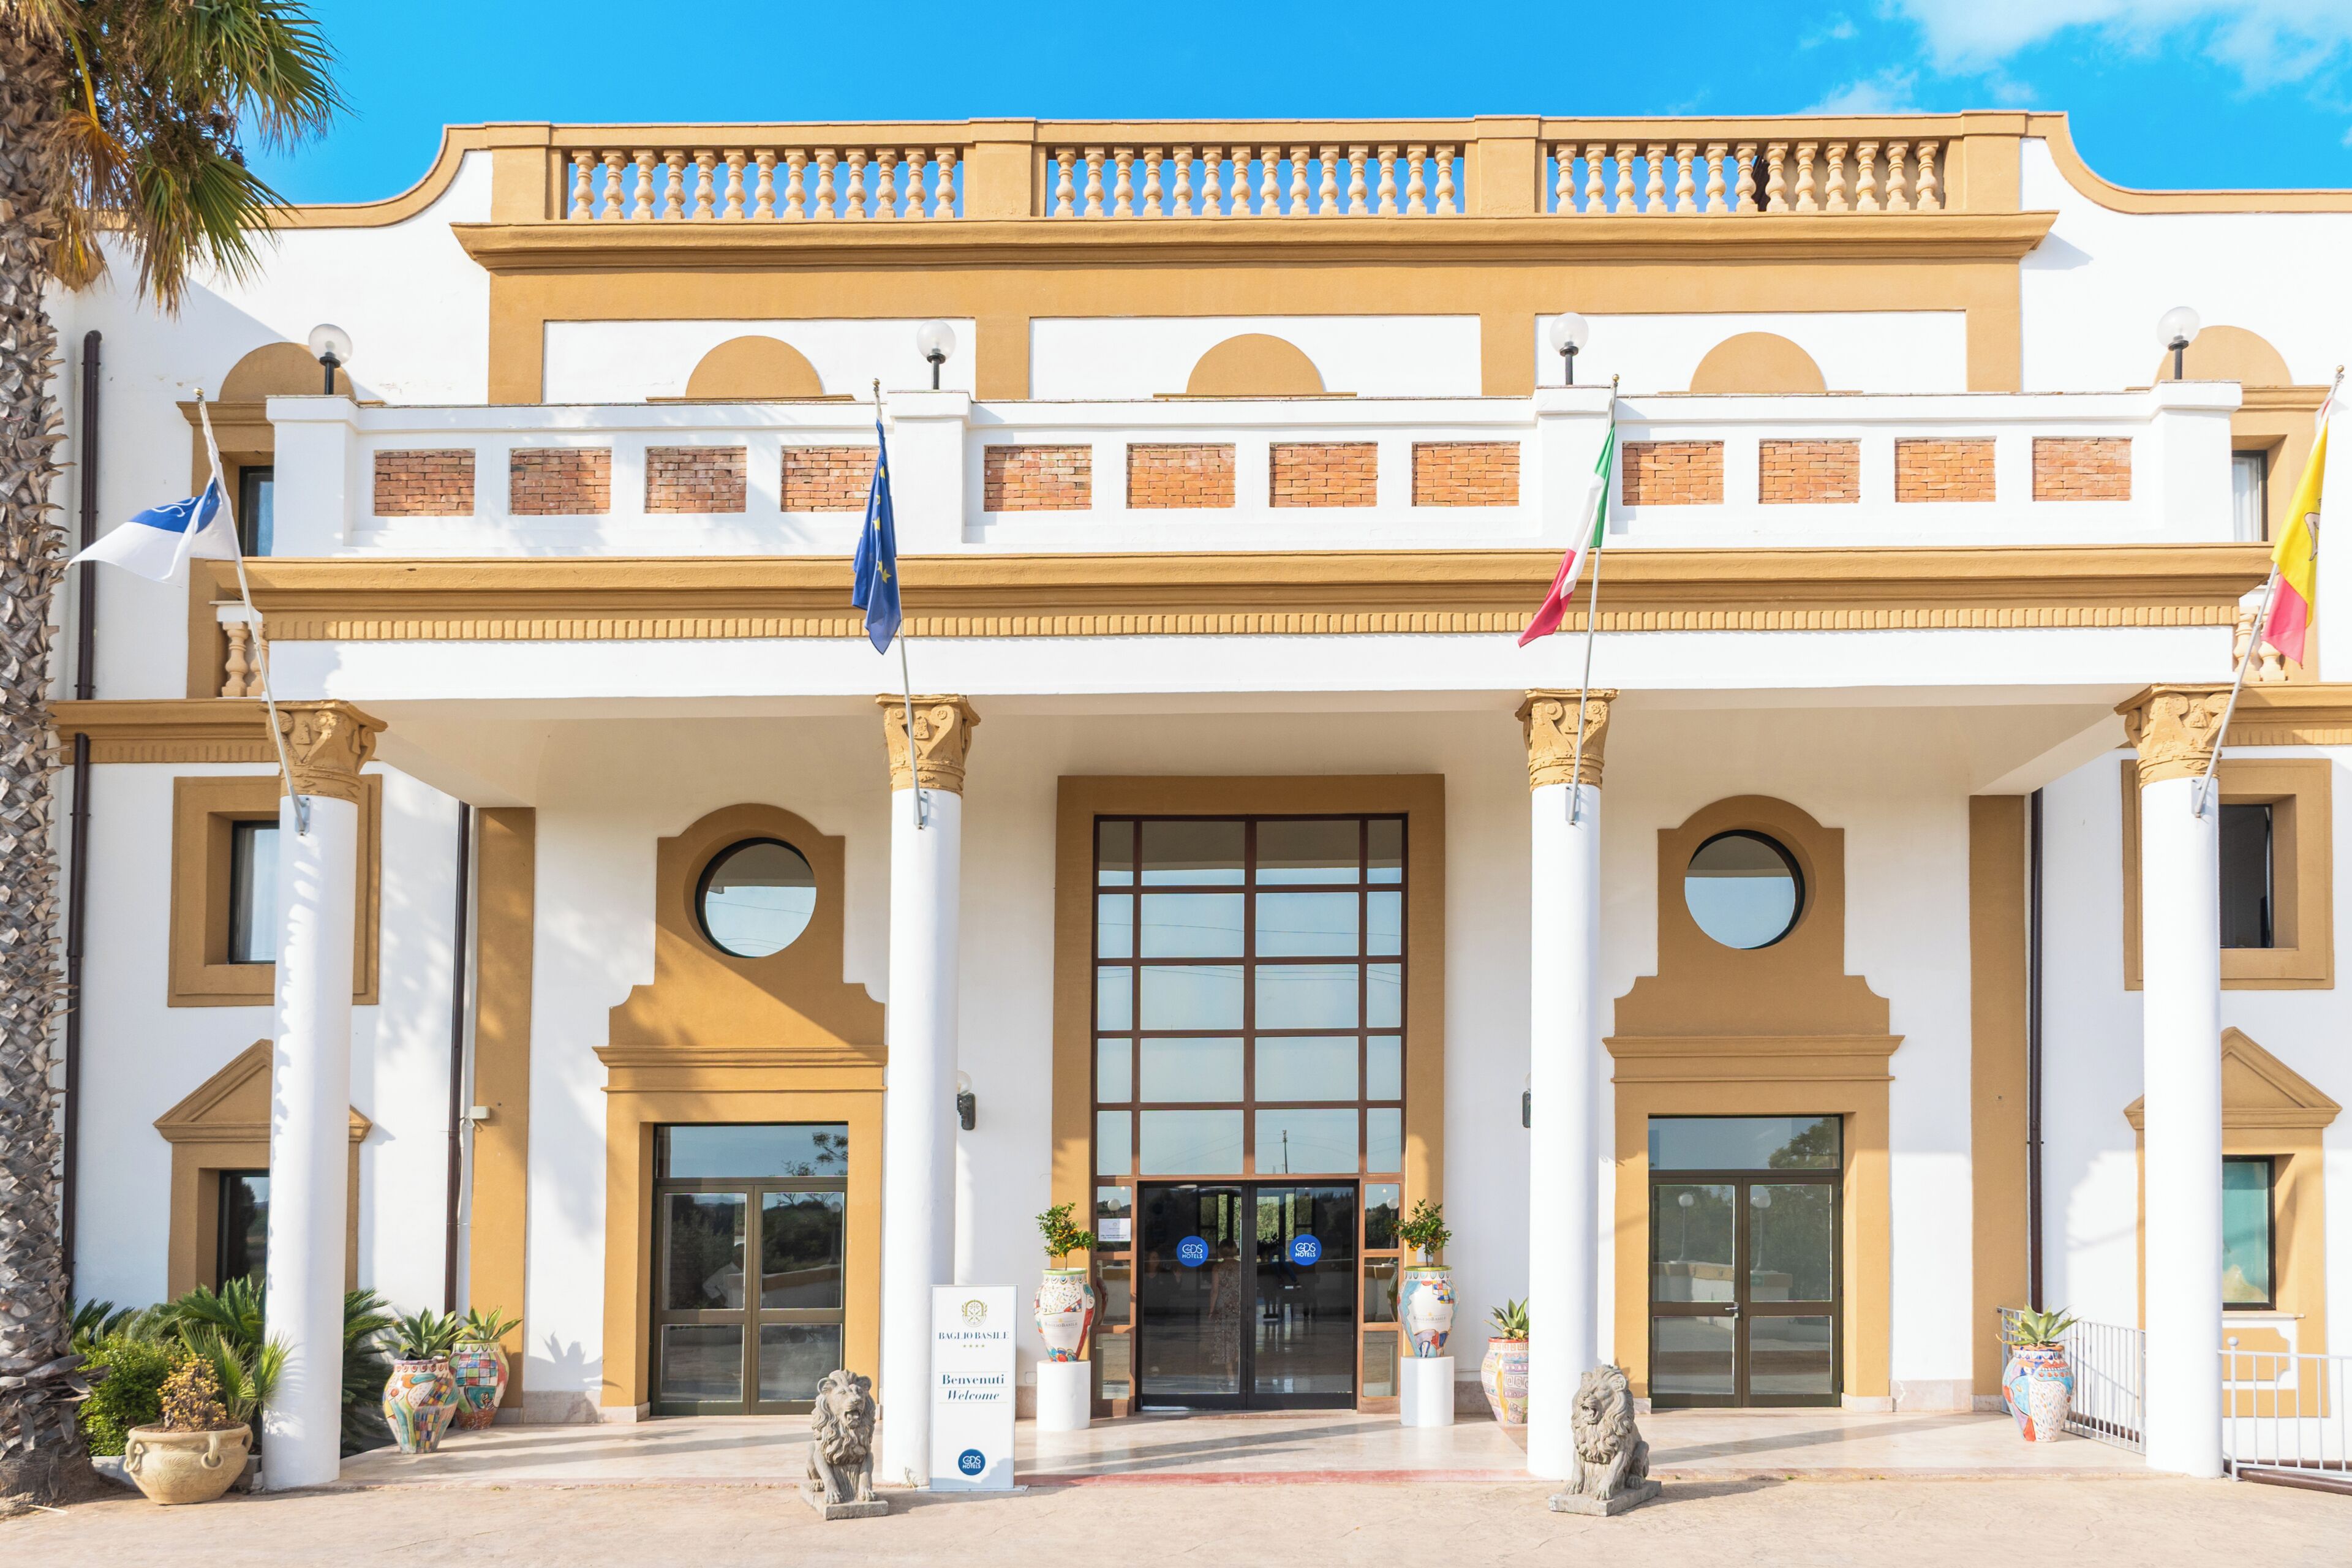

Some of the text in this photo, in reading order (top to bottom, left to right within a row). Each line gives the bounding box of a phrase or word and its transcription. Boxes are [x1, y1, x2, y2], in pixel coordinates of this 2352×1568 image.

[975, 1331, 1009, 1340] BASILE
[943, 1374, 1005, 1384] Benvenuti
[948, 1390, 1000, 1400] Welcome
